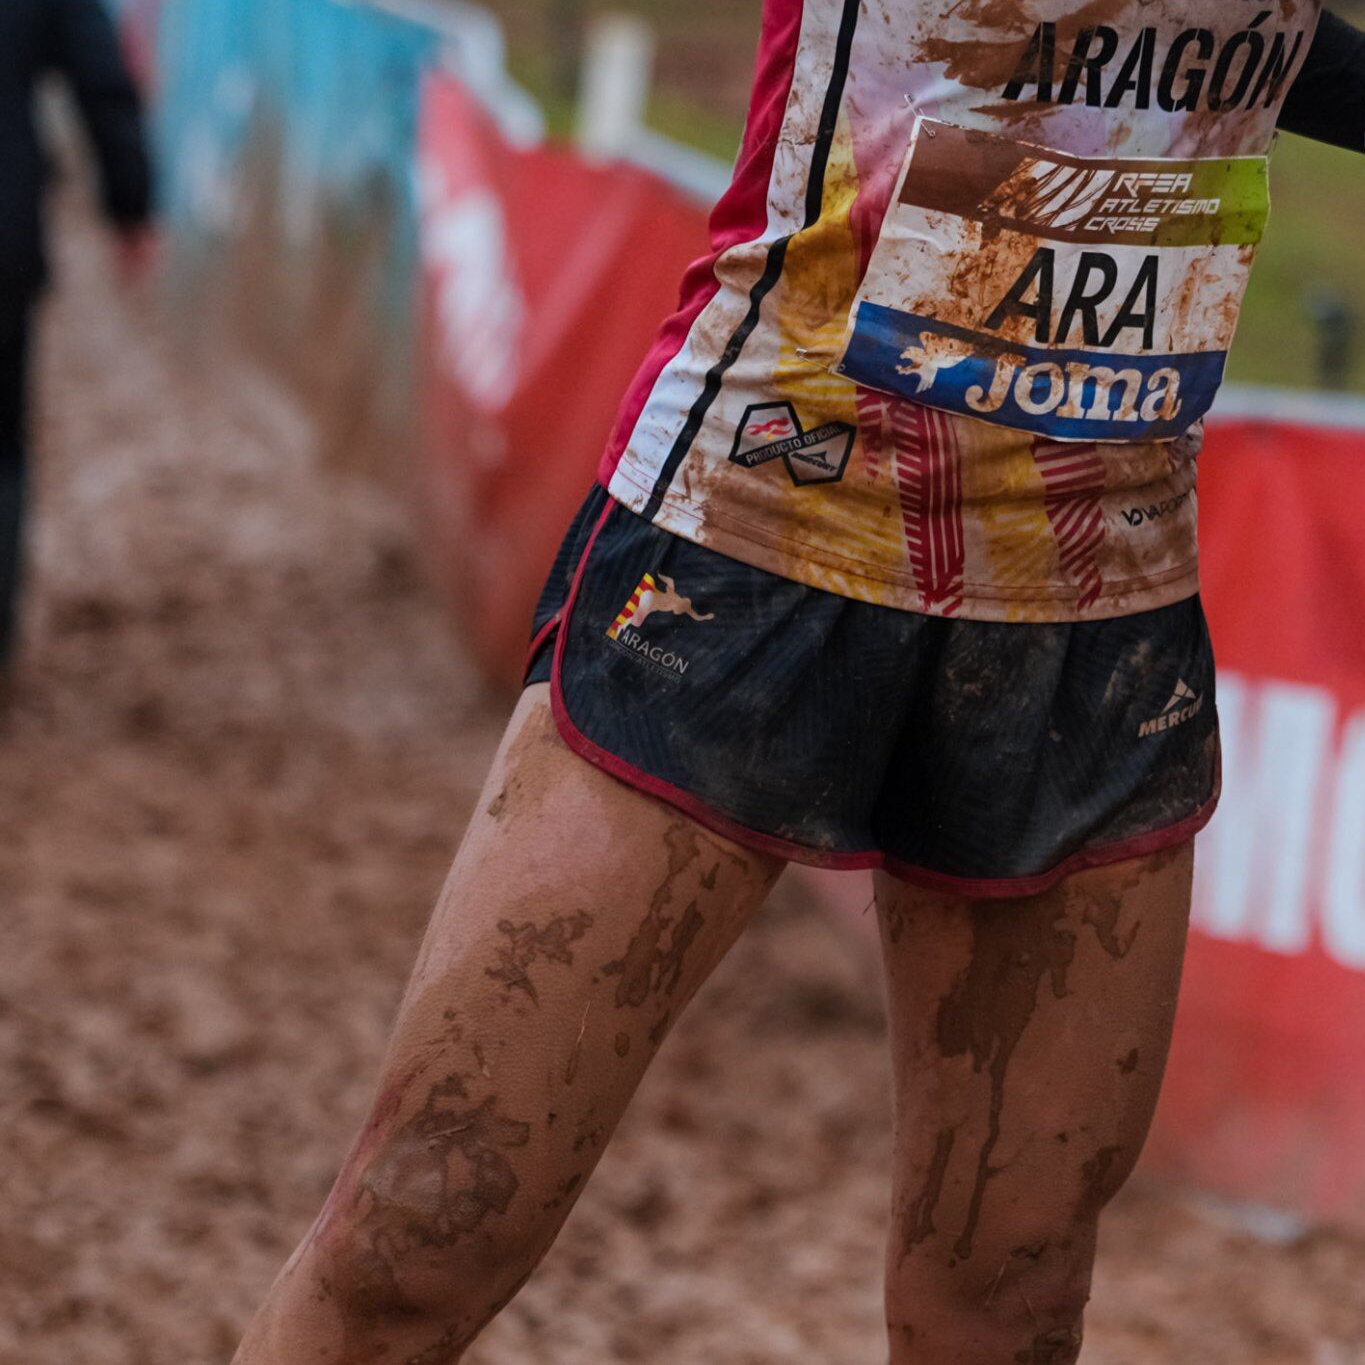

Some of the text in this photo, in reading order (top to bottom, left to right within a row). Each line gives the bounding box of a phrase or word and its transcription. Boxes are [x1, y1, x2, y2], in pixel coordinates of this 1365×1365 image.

[1002, 11, 1303, 112] ARAGÓN
[1112, 173, 1193, 197] RFEA
[1099, 199, 1220, 214] ATLETISMO
[1084, 217, 1160, 234] CROSS
[984, 248, 1159, 349] ARA
[746, 439, 802, 465] PRODUCTO
[621, 629, 689, 673] ARAGÓN
